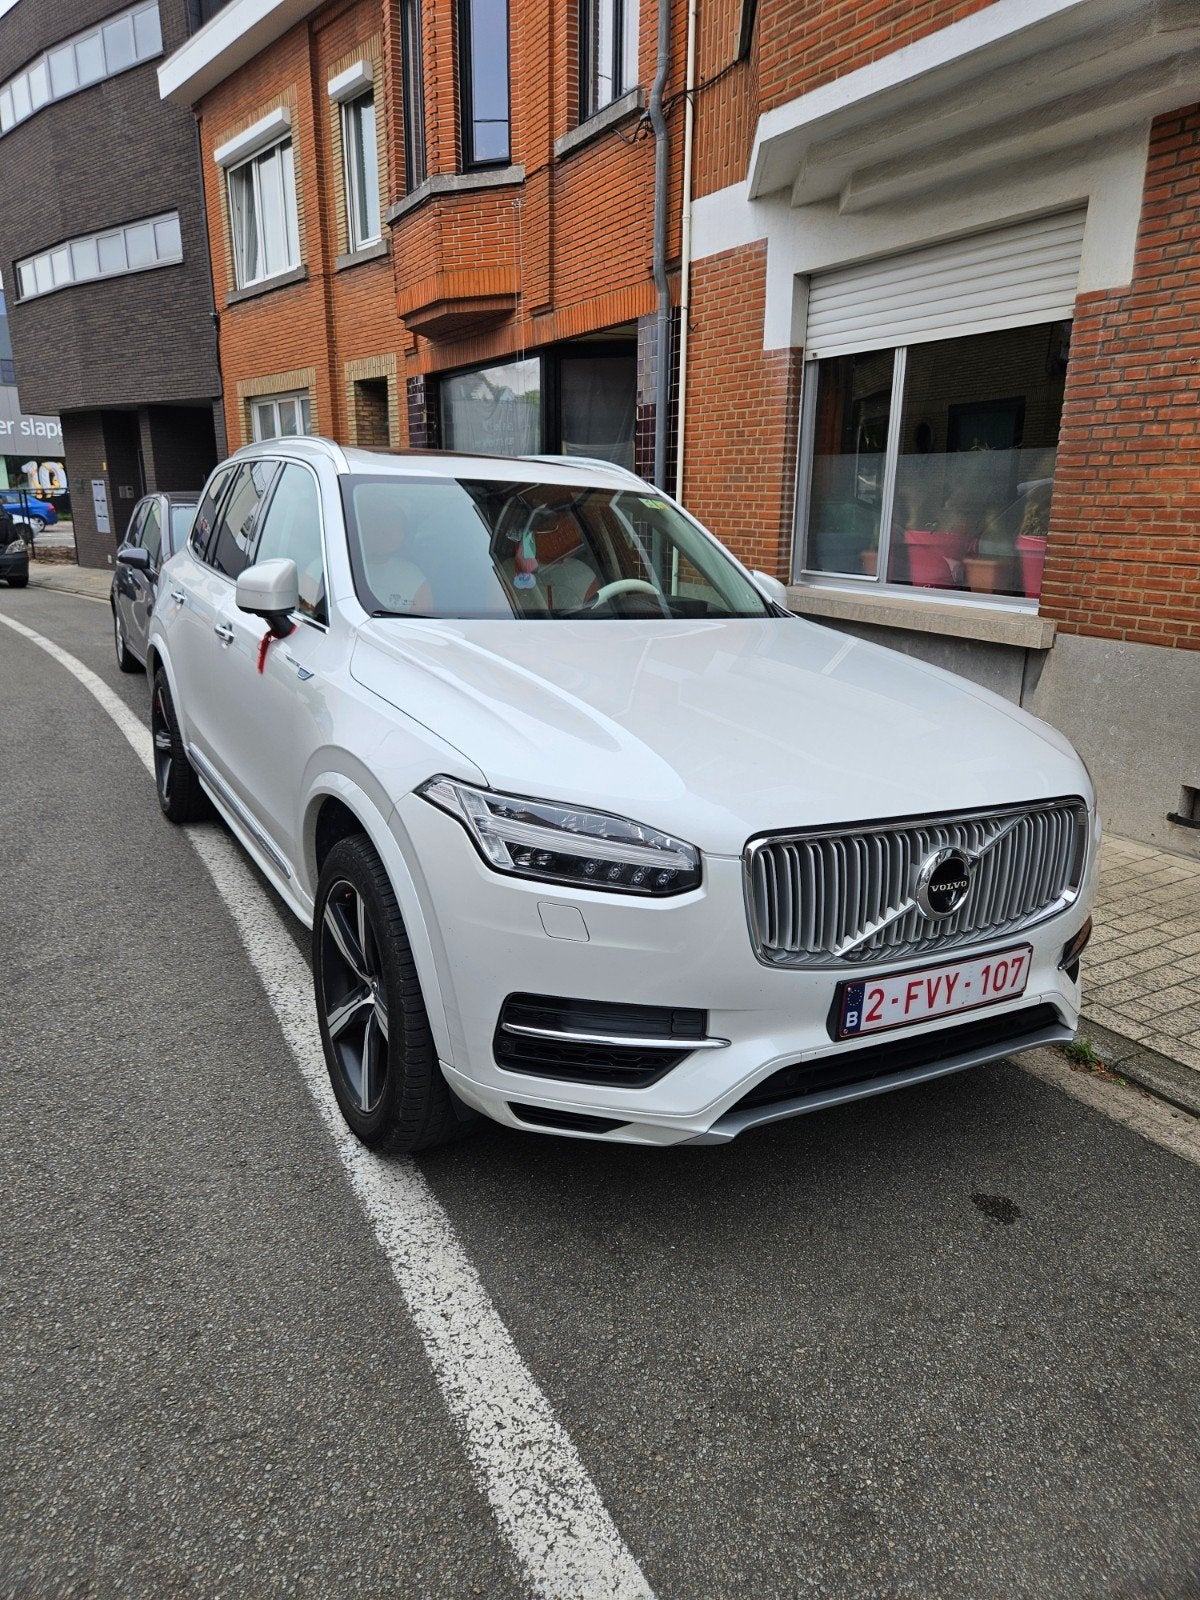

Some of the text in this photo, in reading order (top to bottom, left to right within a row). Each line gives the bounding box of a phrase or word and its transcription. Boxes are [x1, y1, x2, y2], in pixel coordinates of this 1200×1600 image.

[21, 460, 68, 498] 10
[930, 880, 968, 892] VOLVO
[846, 1011, 858, 1028] B
